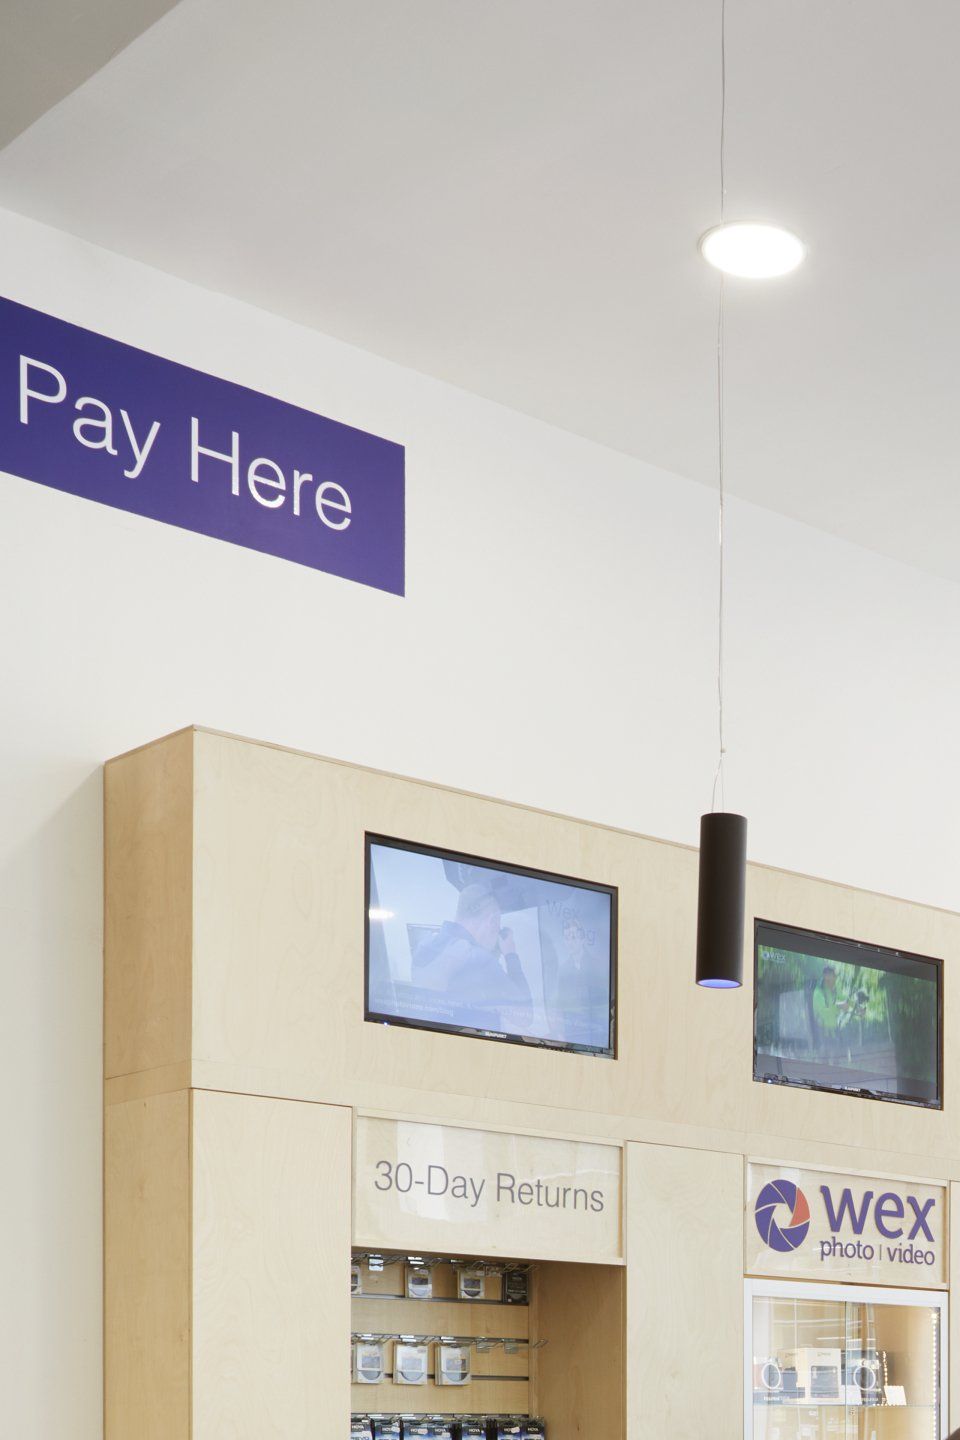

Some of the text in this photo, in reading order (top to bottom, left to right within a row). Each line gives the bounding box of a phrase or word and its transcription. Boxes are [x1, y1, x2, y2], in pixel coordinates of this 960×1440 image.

[18, 354, 353, 531] Pay Here
[374, 1160, 605, 1212] 30-Day Returns
[820, 1185, 936, 1243] wex
[820, 1236, 936, 1266] photo video
